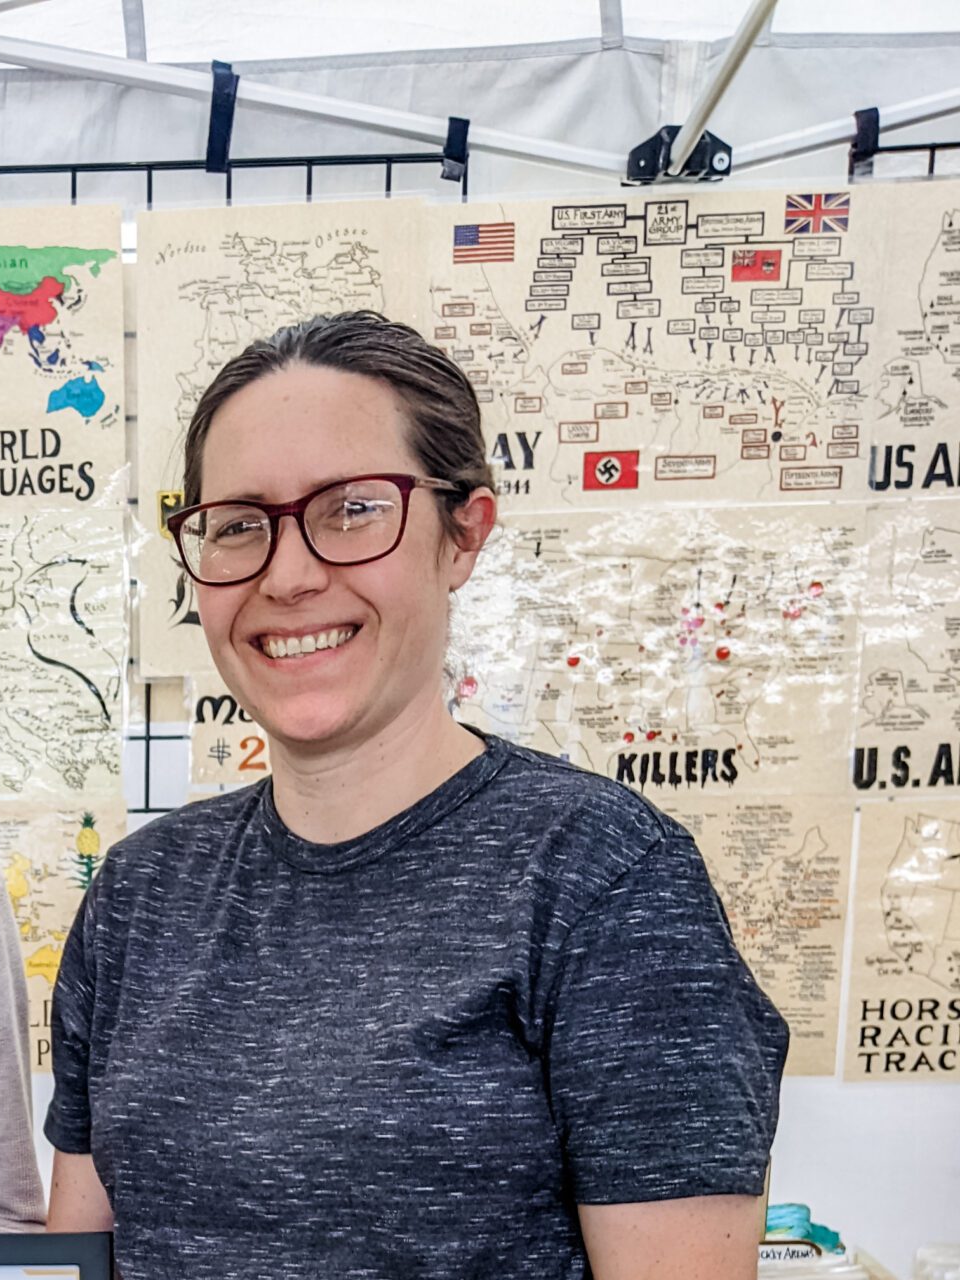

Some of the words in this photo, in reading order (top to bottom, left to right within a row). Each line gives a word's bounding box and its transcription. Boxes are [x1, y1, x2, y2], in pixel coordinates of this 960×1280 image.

[649, 225, 683, 234] GROUP
[652, 215, 681, 226] ARMY
[491, 431, 542, 470] AY
[868, 444, 915, 492] US
[497, 479, 530, 495] 944
[207, 736, 267, 771] $2
[617, 748, 739, 795] KILLERS
[852, 745, 921, 790] U.S.
[927, 743, 960, 787] A
[861, 998, 960, 1021] HORS
[859, 1024, 960, 1048] RACI
[858, 1049, 957, 1073] TRAC
[760, 1248, 781, 1259] CKEY
